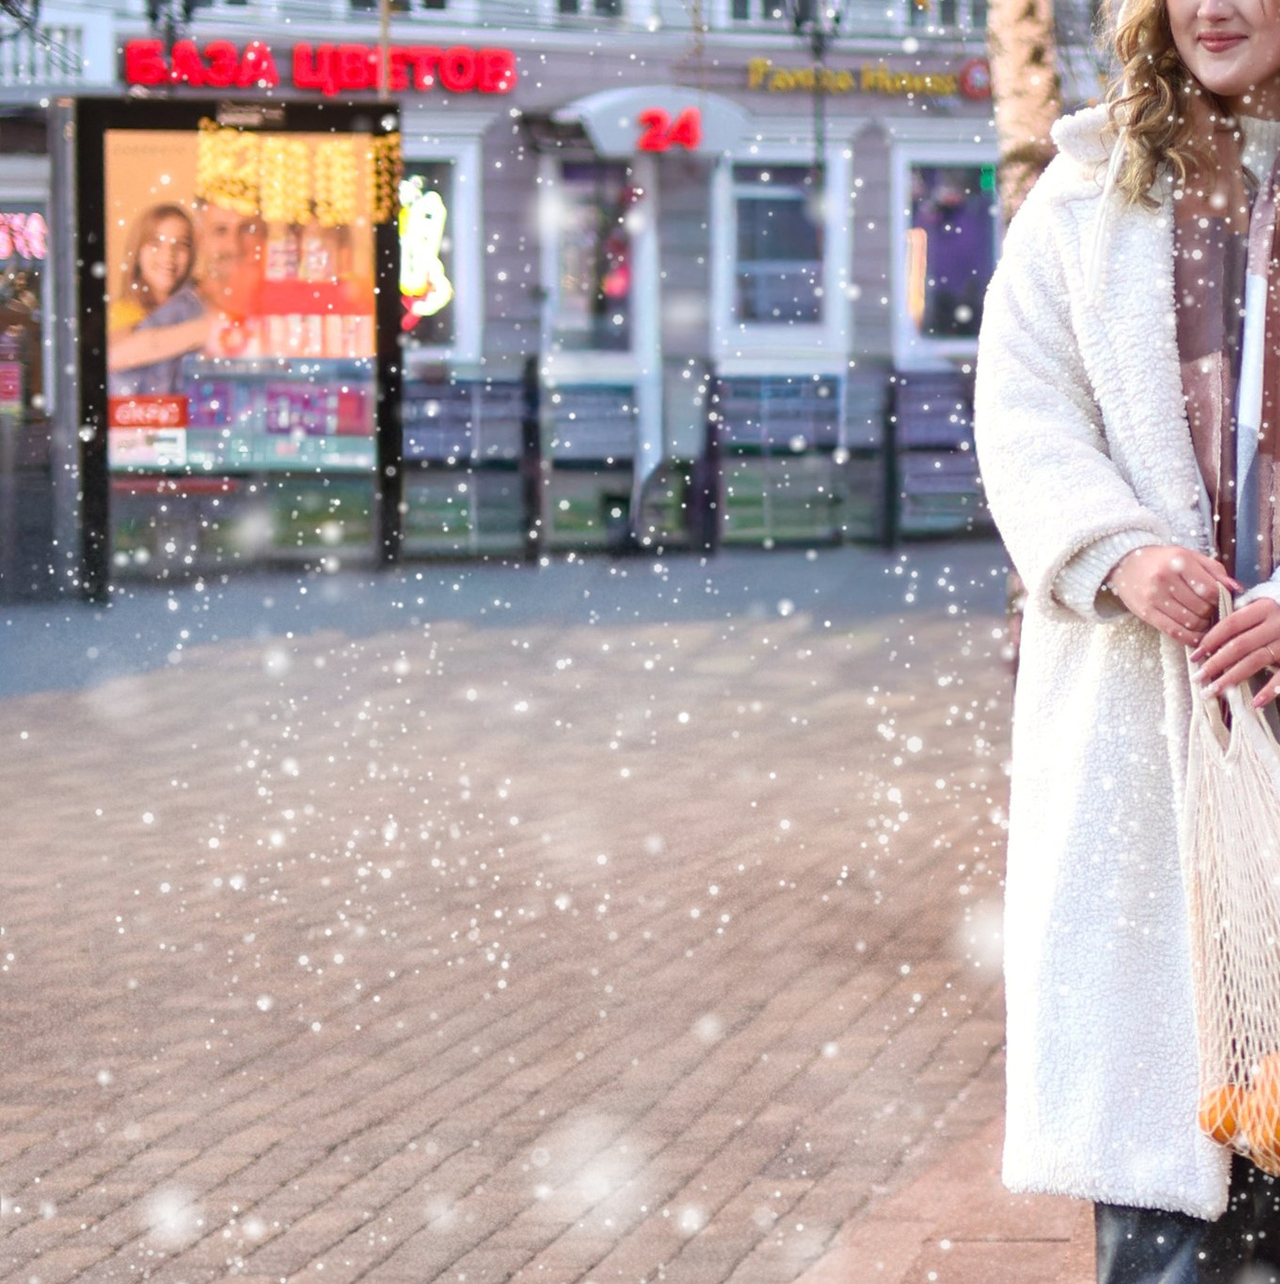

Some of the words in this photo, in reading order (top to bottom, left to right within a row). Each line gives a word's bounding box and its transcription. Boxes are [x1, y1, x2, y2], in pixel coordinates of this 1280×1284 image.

[126, 40, 280, 89] БАЗА
[293, 42, 518, 97] ЦВЕТОВ
[638, 106, 703, 153] 24
